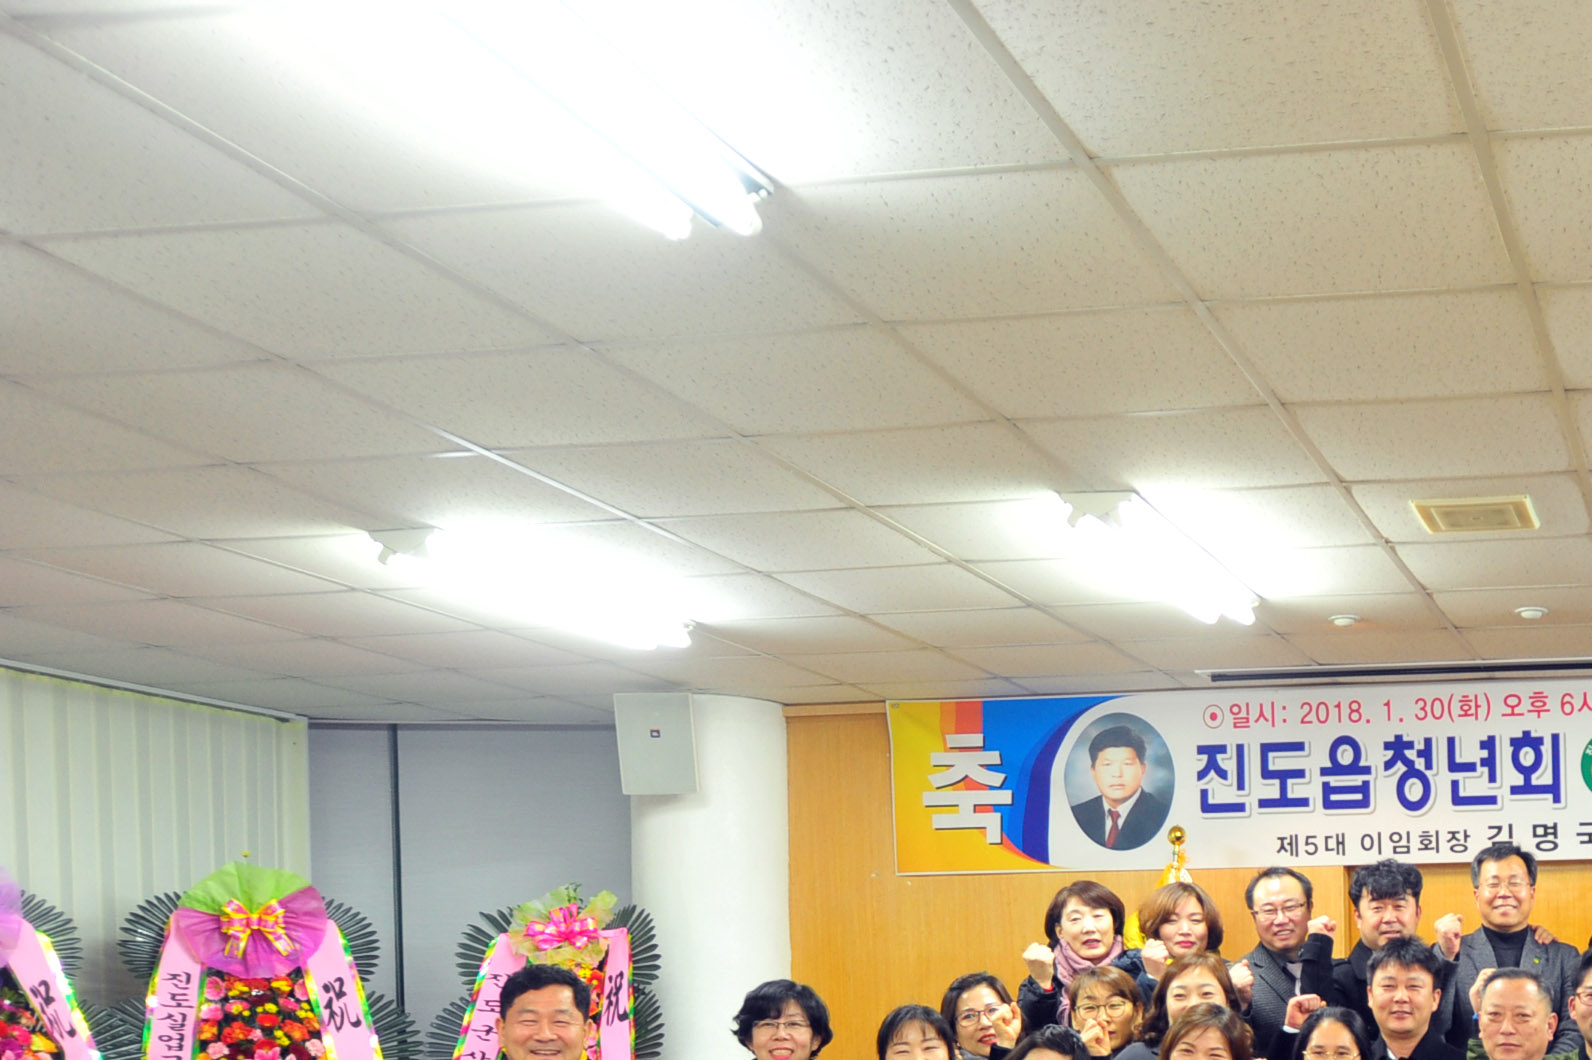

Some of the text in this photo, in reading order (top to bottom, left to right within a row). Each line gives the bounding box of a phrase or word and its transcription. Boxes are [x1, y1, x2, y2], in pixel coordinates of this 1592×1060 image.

[1228, 701, 1288, 729] 일시:
[1299, 699, 1371, 725] 2018.
[1382, 698, 1404, 723] 1.
[1413, 692, 1491, 723] 30(화)
[1500, 691, 1551, 719] 오후
[922, 733, 1014, 845] 축
[1196, 729, 1564, 815] 진도읍청년회
[1276, 832, 1347, 858] 제5대
[1360, 829, 1471, 856] 이임회장
